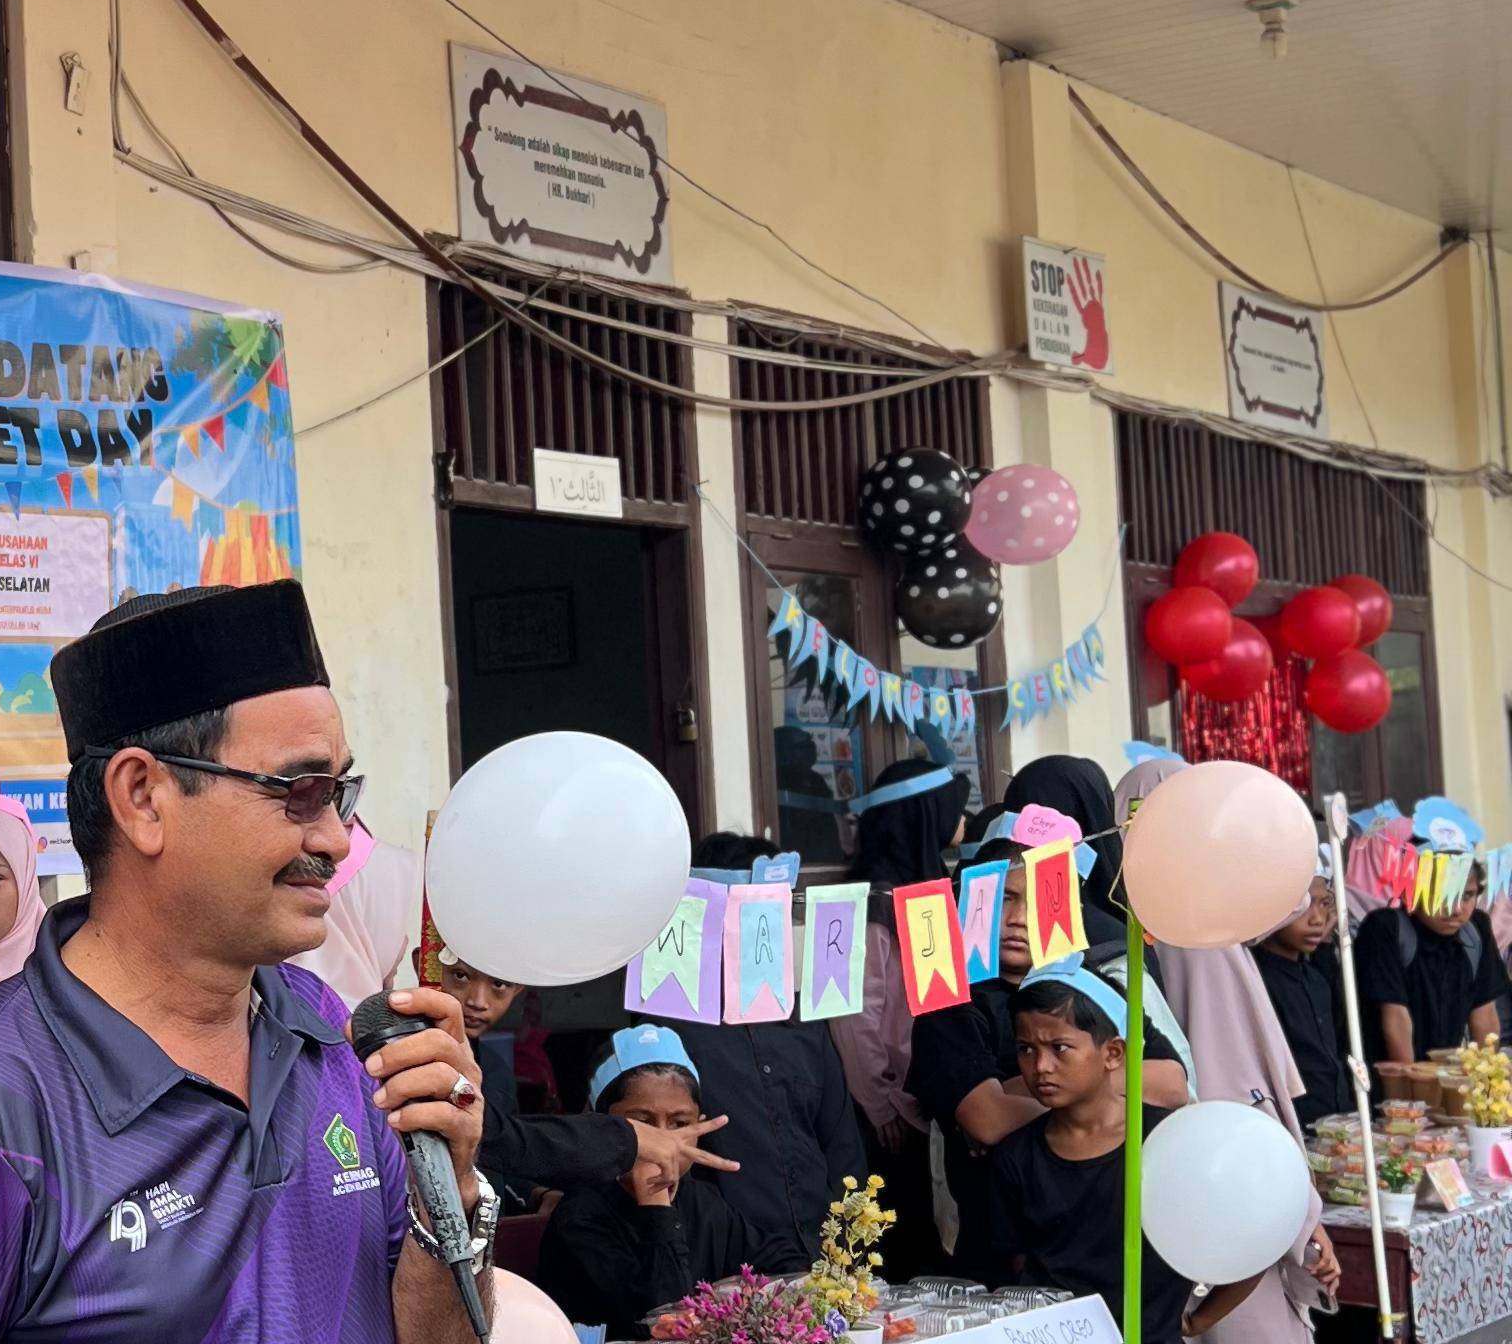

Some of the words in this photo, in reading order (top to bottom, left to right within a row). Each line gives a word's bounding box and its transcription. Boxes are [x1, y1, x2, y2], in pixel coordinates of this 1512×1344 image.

[1030, 260, 1064, 297] STOP
[58, 408, 154, 469] DAY
[29, 557, 38, 568] VI
[0, 576, 50, 592] SELATAN
[786, 596, 972, 720] KELOMPOK
[145, 1181, 170, 1200] HARI
[149, 1189, 182, 1211] AMAL
[152, 1194, 195, 1219] BHAKTI
[1059, 1318, 1094, 1344] OREO
